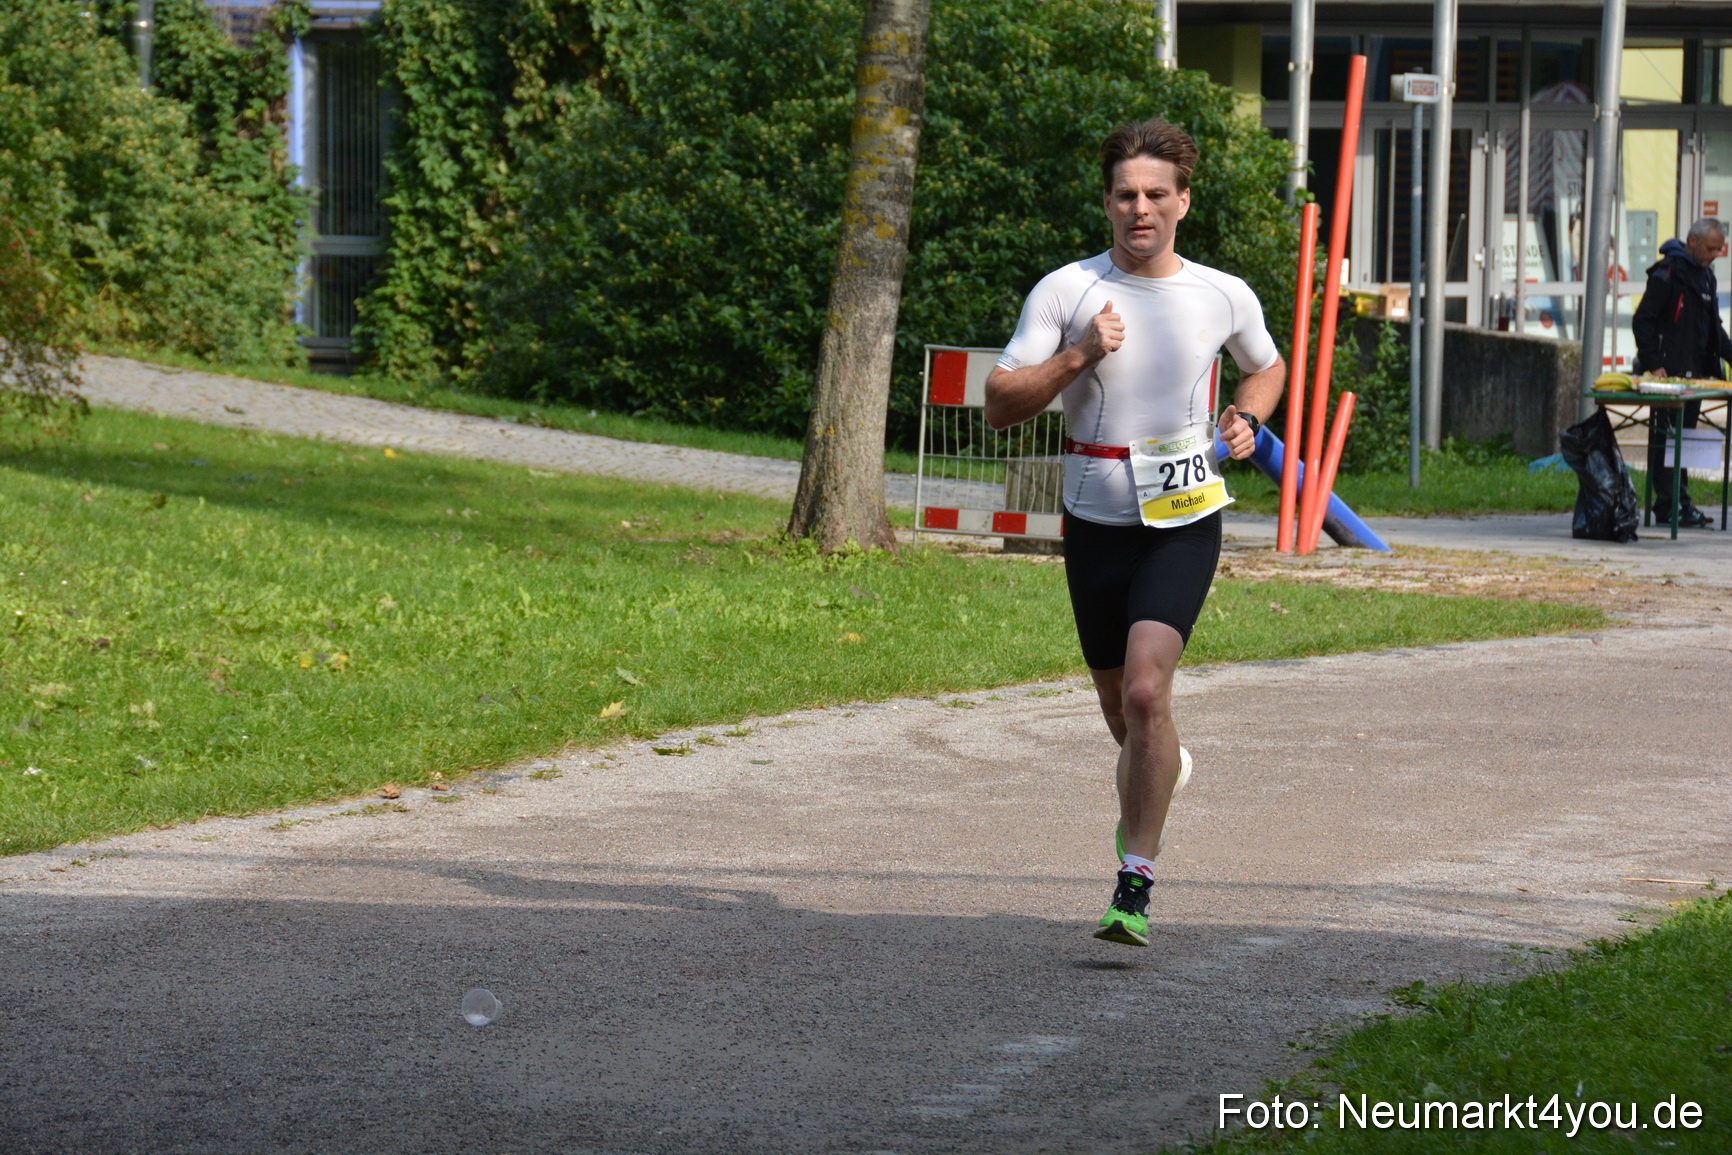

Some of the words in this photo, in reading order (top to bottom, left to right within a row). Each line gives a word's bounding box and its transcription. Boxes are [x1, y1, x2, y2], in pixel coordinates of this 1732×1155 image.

[1503, 244, 1545, 258] STNDE
[1159, 453, 1206, 491] 278
[1171, 492, 1205, 510] Michael
